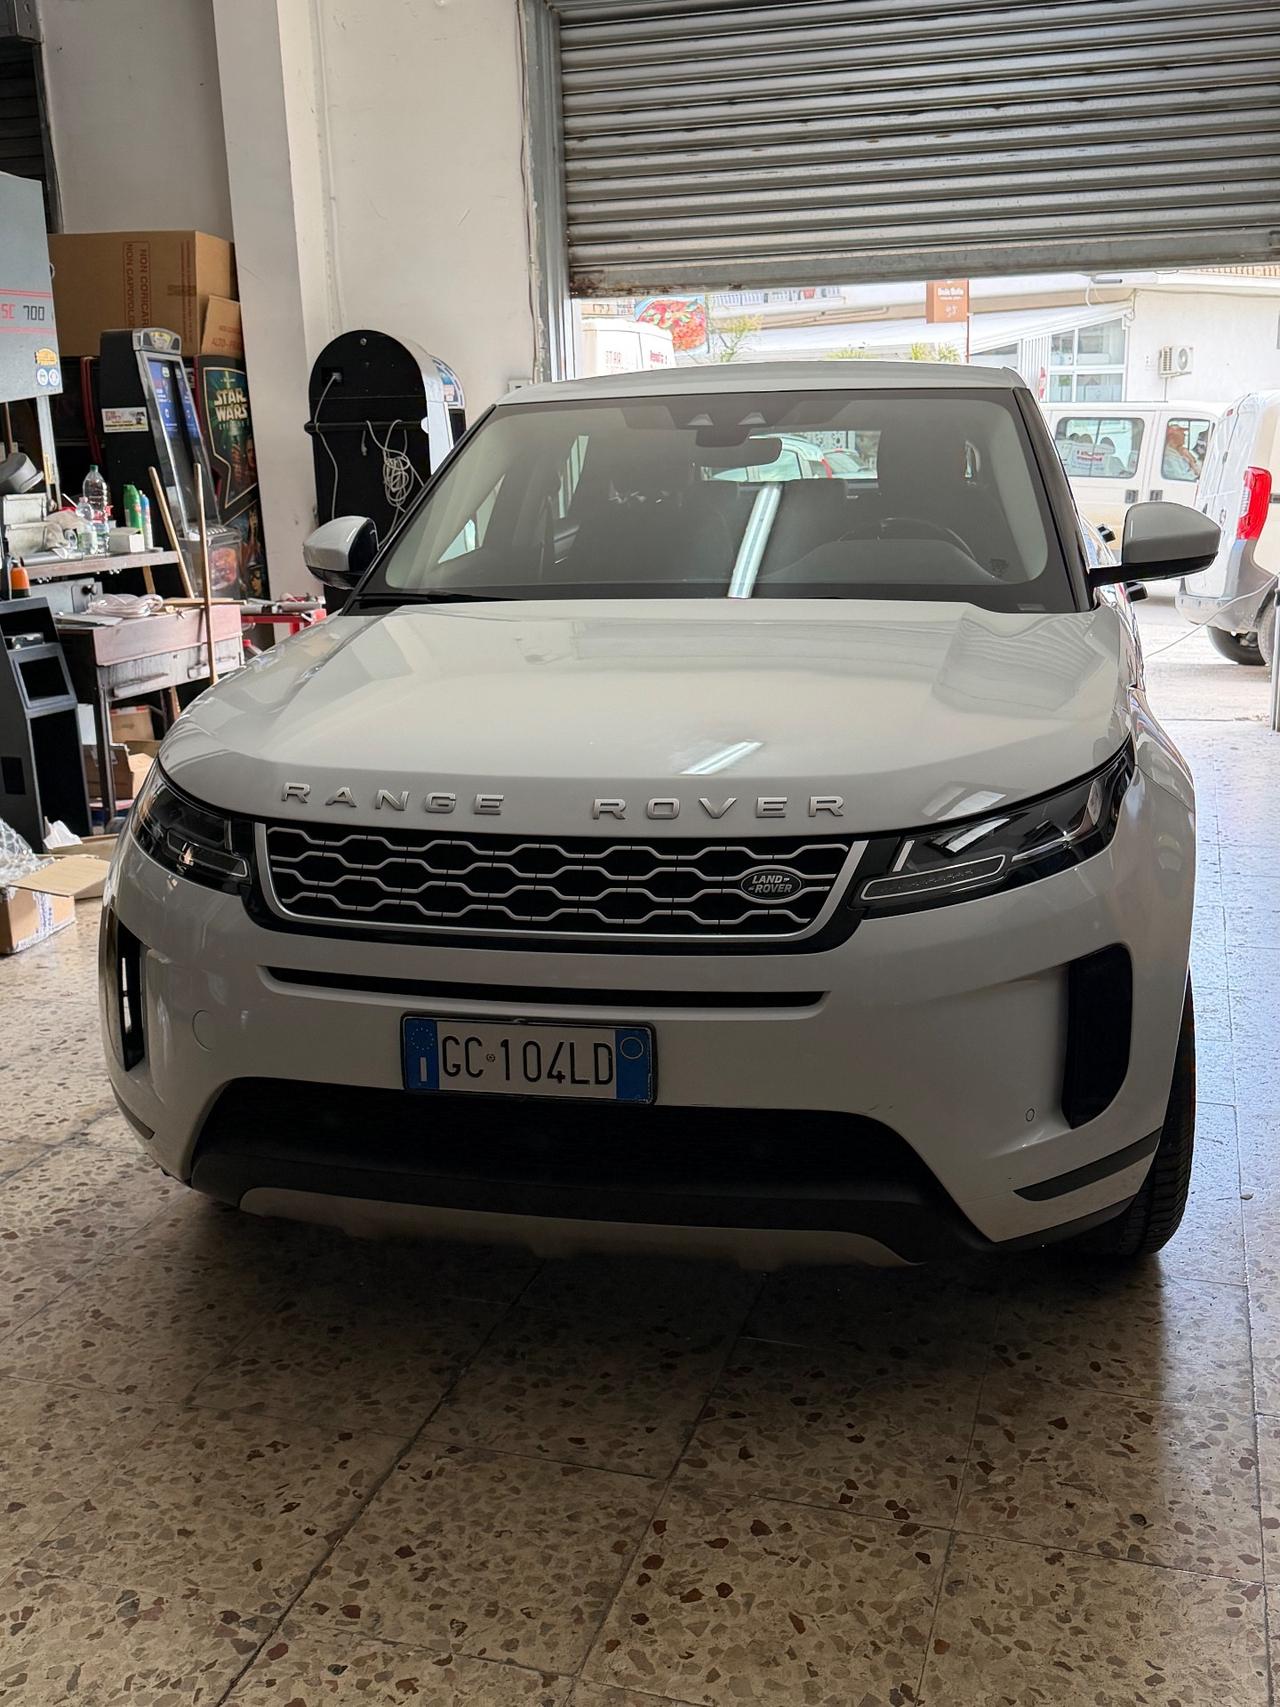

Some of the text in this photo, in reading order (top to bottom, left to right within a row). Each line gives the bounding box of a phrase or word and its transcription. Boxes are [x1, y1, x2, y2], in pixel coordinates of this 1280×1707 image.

[139, 276, 149, 329] CORICAR
[23, 305, 45, 321] 700
[213, 387, 247, 406] STAR
[215, 404, 249, 422] WARS
[281, 782, 844, 820] RANGE ROVER
[754, 883, 793, 894] ROVER
